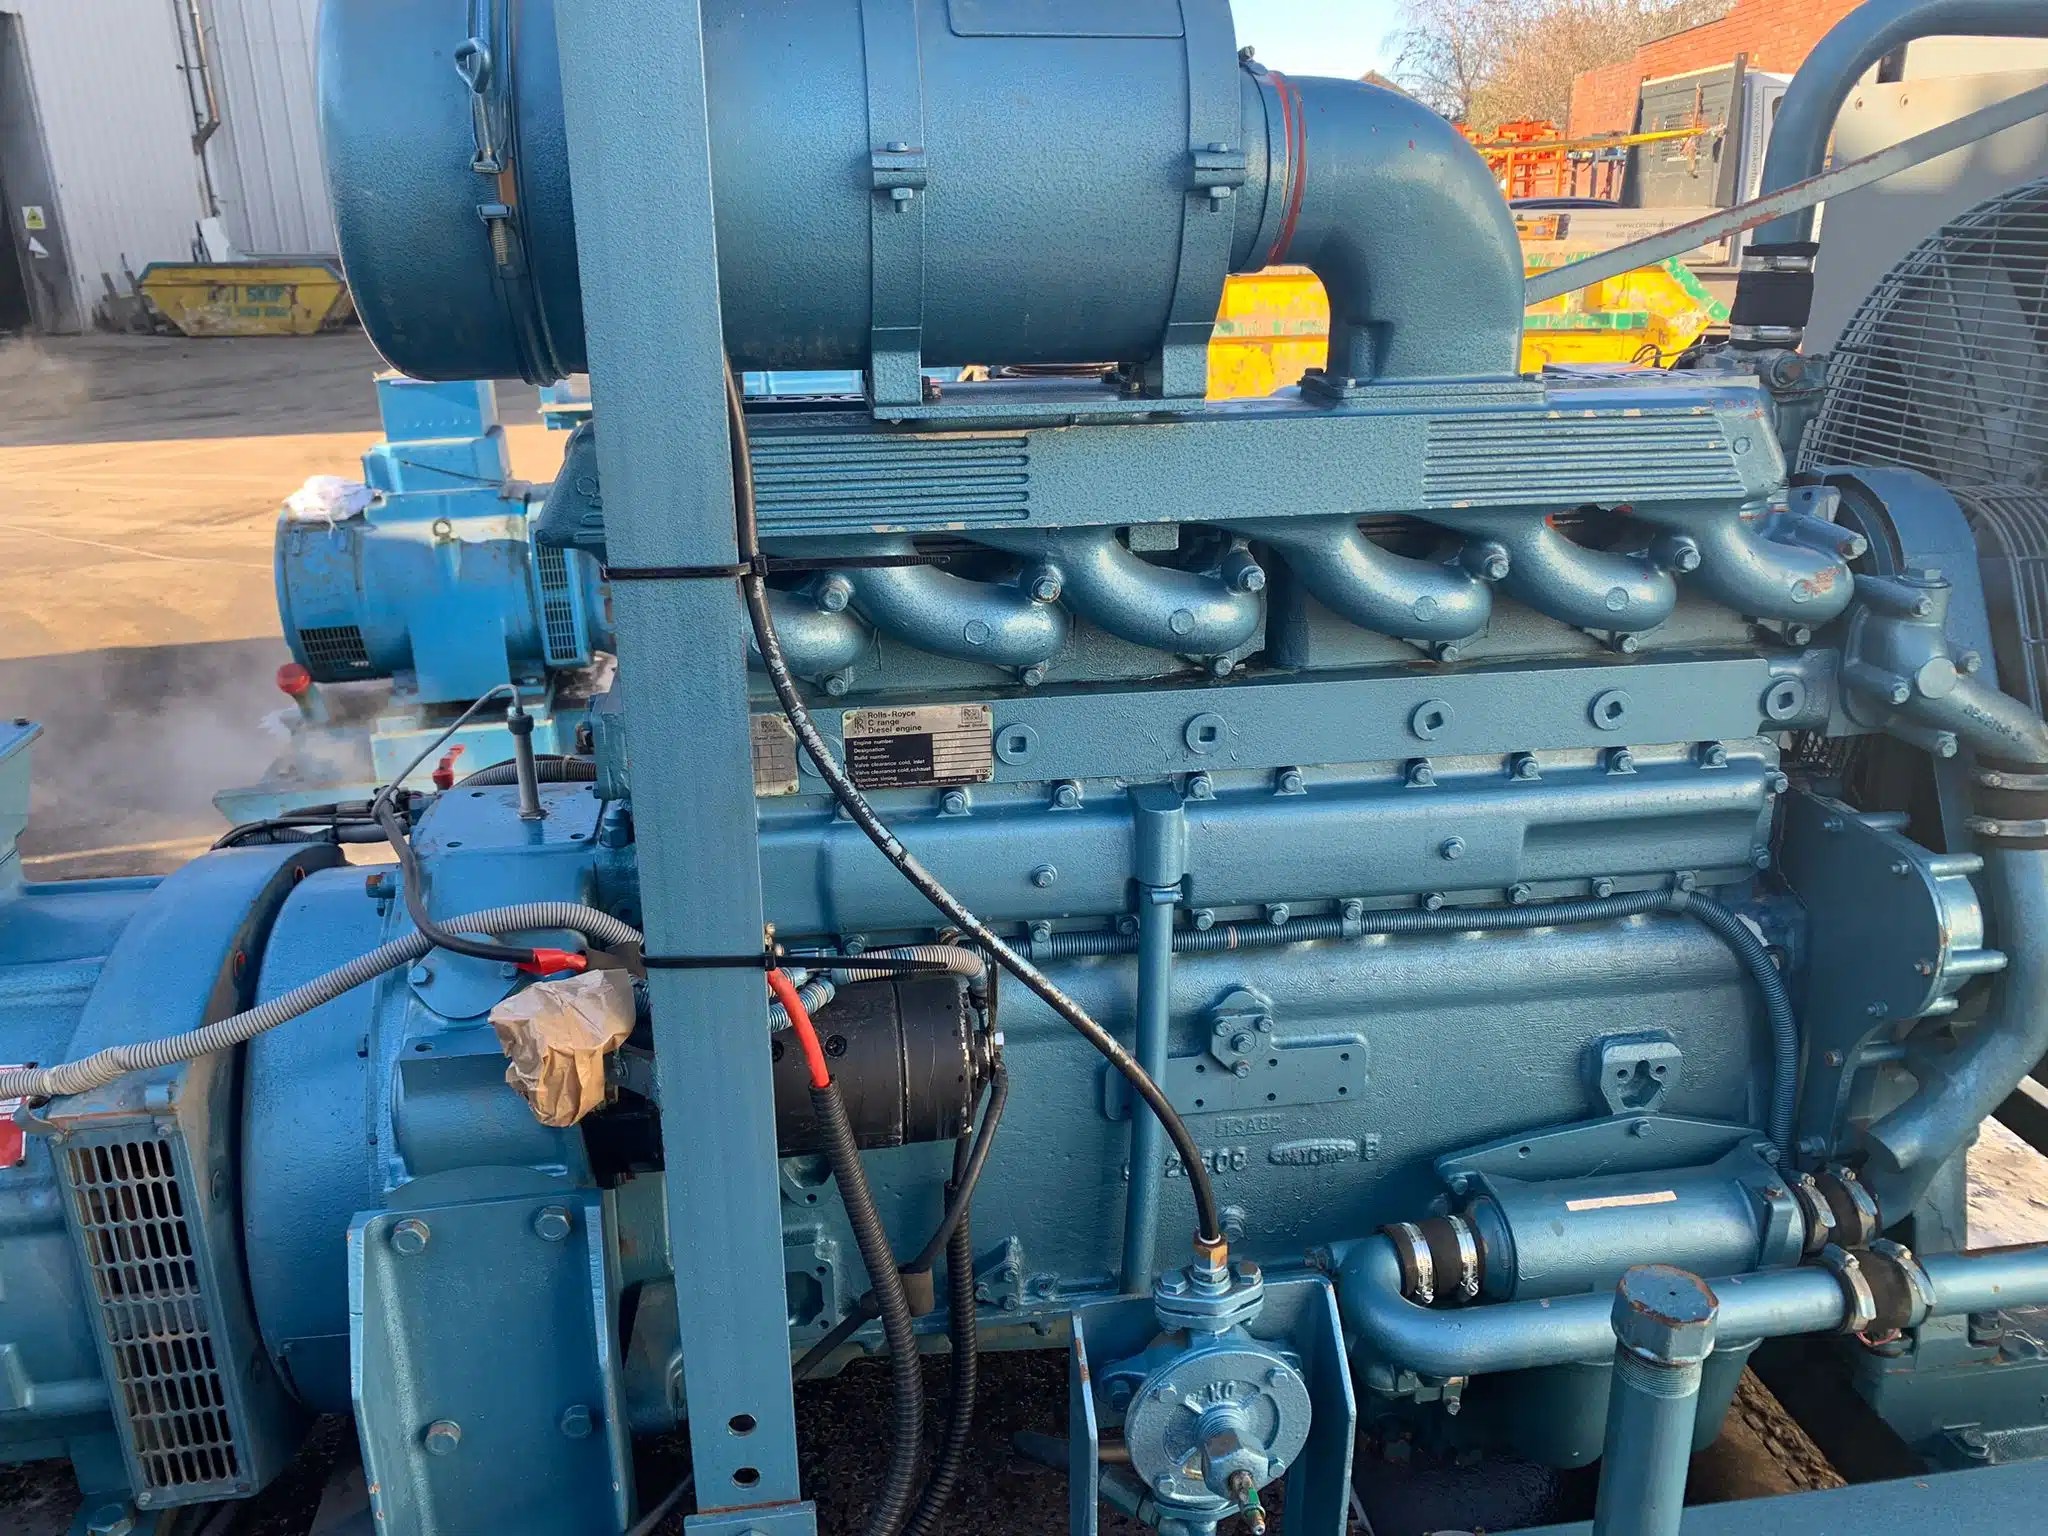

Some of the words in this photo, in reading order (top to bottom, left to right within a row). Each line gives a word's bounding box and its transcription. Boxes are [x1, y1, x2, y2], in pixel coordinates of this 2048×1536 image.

[868, 710, 916, 719] Rolls-Royce
[868, 719, 874, 727] C
[878, 719, 900, 727] range
[868, 726, 892, 734] Diesel
[896, 725, 922, 733] engine
